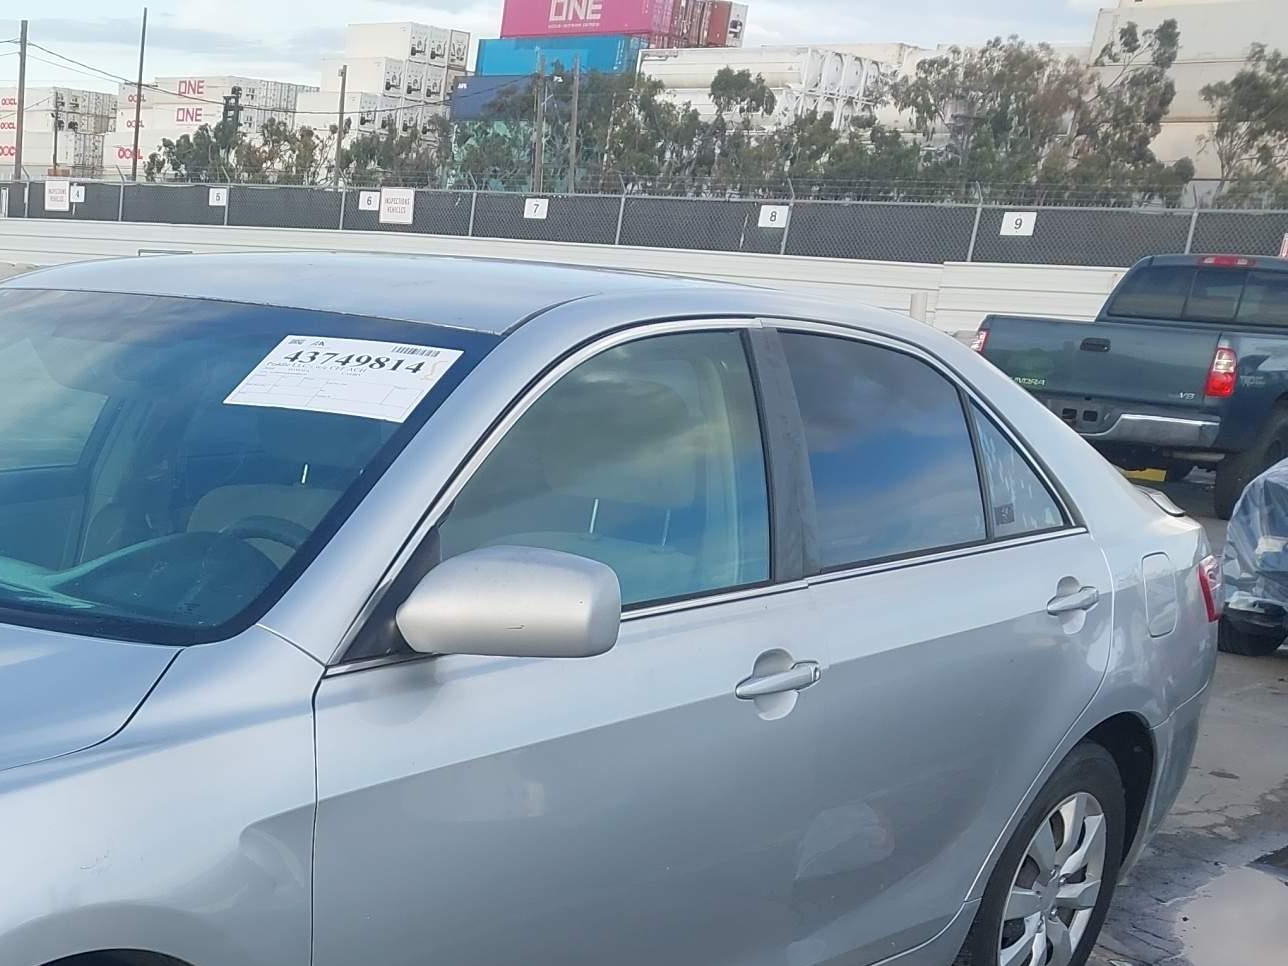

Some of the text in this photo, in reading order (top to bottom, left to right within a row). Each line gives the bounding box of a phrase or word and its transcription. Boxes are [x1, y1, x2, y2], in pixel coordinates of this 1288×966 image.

[548, 0, 602, 21] ONE
[178, 80, 205, 95] ONE
[128, 94, 146, 103] OOL
[176, 108, 202, 122] ONE
[0, 122, 16, 130] OOCL
[126, 120, 144, 128] OOL
[215, 192, 221, 201] 5
[366, 196, 372, 206] 6
[533, 203, 540, 214] 7
[769, 211, 777, 222] 8
[1014, 217, 1023, 230] 9
[283, 350, 425, 374] 43749814
